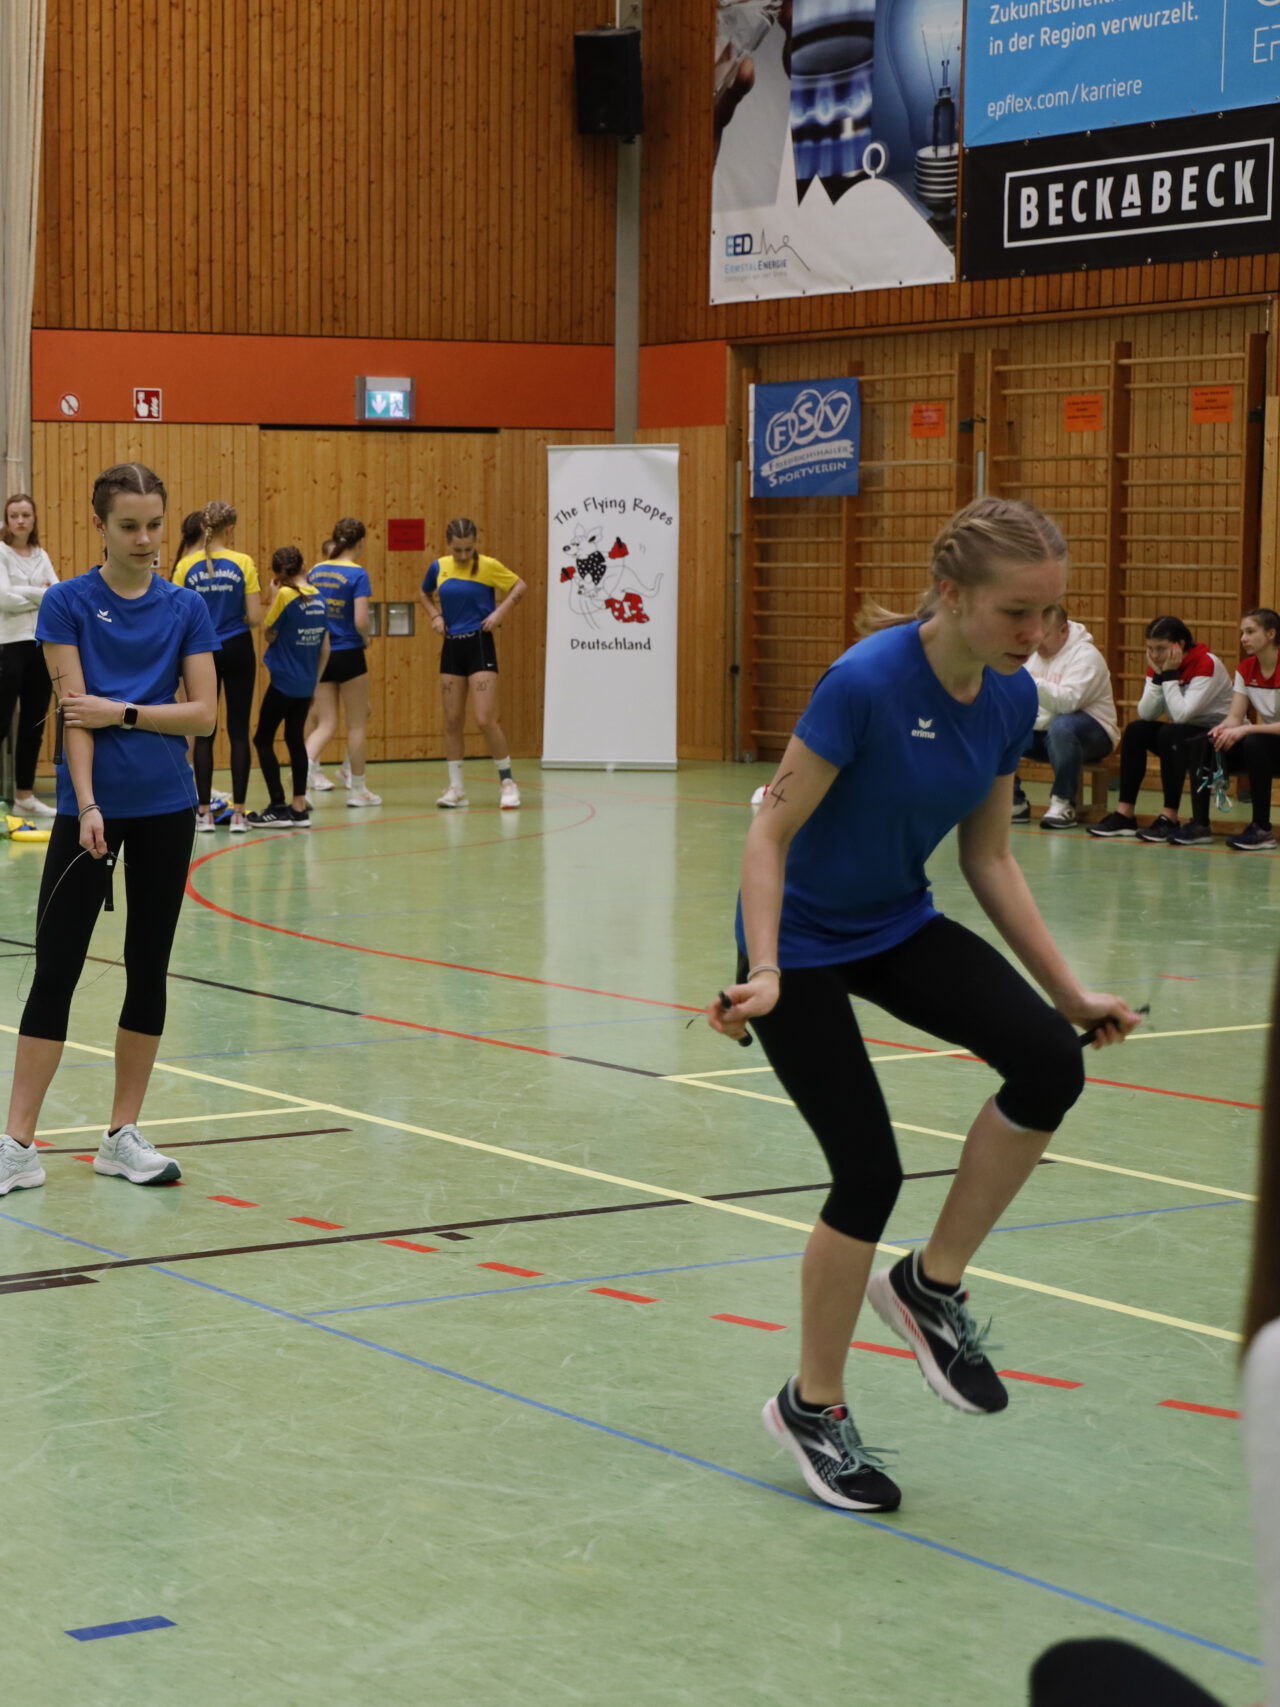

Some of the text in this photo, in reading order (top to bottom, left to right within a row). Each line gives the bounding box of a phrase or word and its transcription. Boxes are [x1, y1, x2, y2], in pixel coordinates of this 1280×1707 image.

[989, 4, 1199, 56] in der Region verwurzelt.
[987, 78, 1143, 120] epflex.com/karriere
[768, 461, 847, 488] SPORTVEREIN
[554, 496, 673, 526] The Flying Ropes
[571, 637, 651, 650] Deutschland
[911, 729, 935, 739] erima
